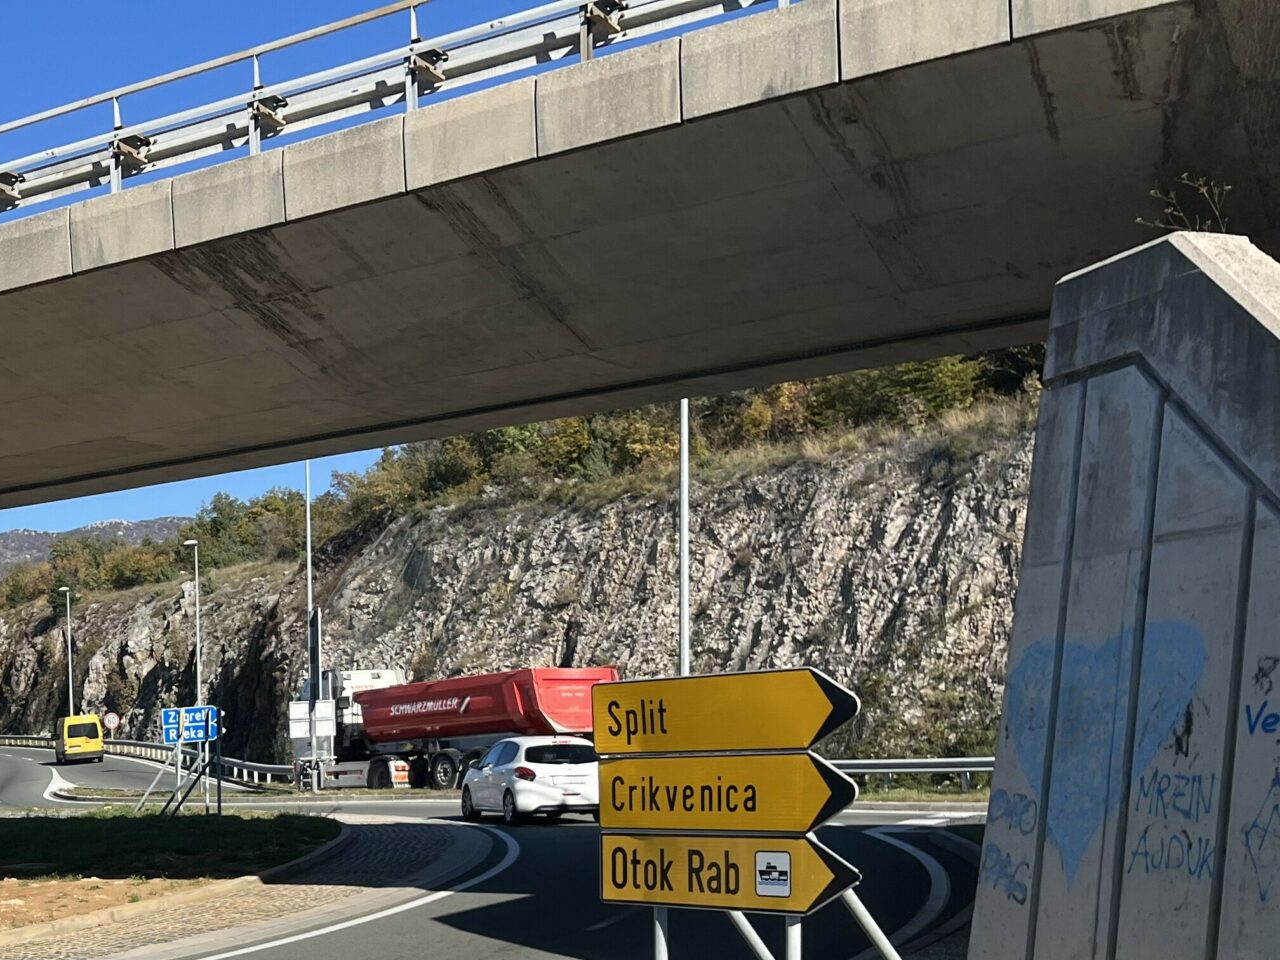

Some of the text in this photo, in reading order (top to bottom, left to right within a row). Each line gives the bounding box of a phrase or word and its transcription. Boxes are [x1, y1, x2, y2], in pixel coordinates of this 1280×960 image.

[168, 709, 207, 726] Zgre
[169, 727, 204, 741] Reka
[607, 699, 668, 745] Split
[611, 775, 757, 812] Crikvenica
[611, 846, 740, 895] Otok Rab
